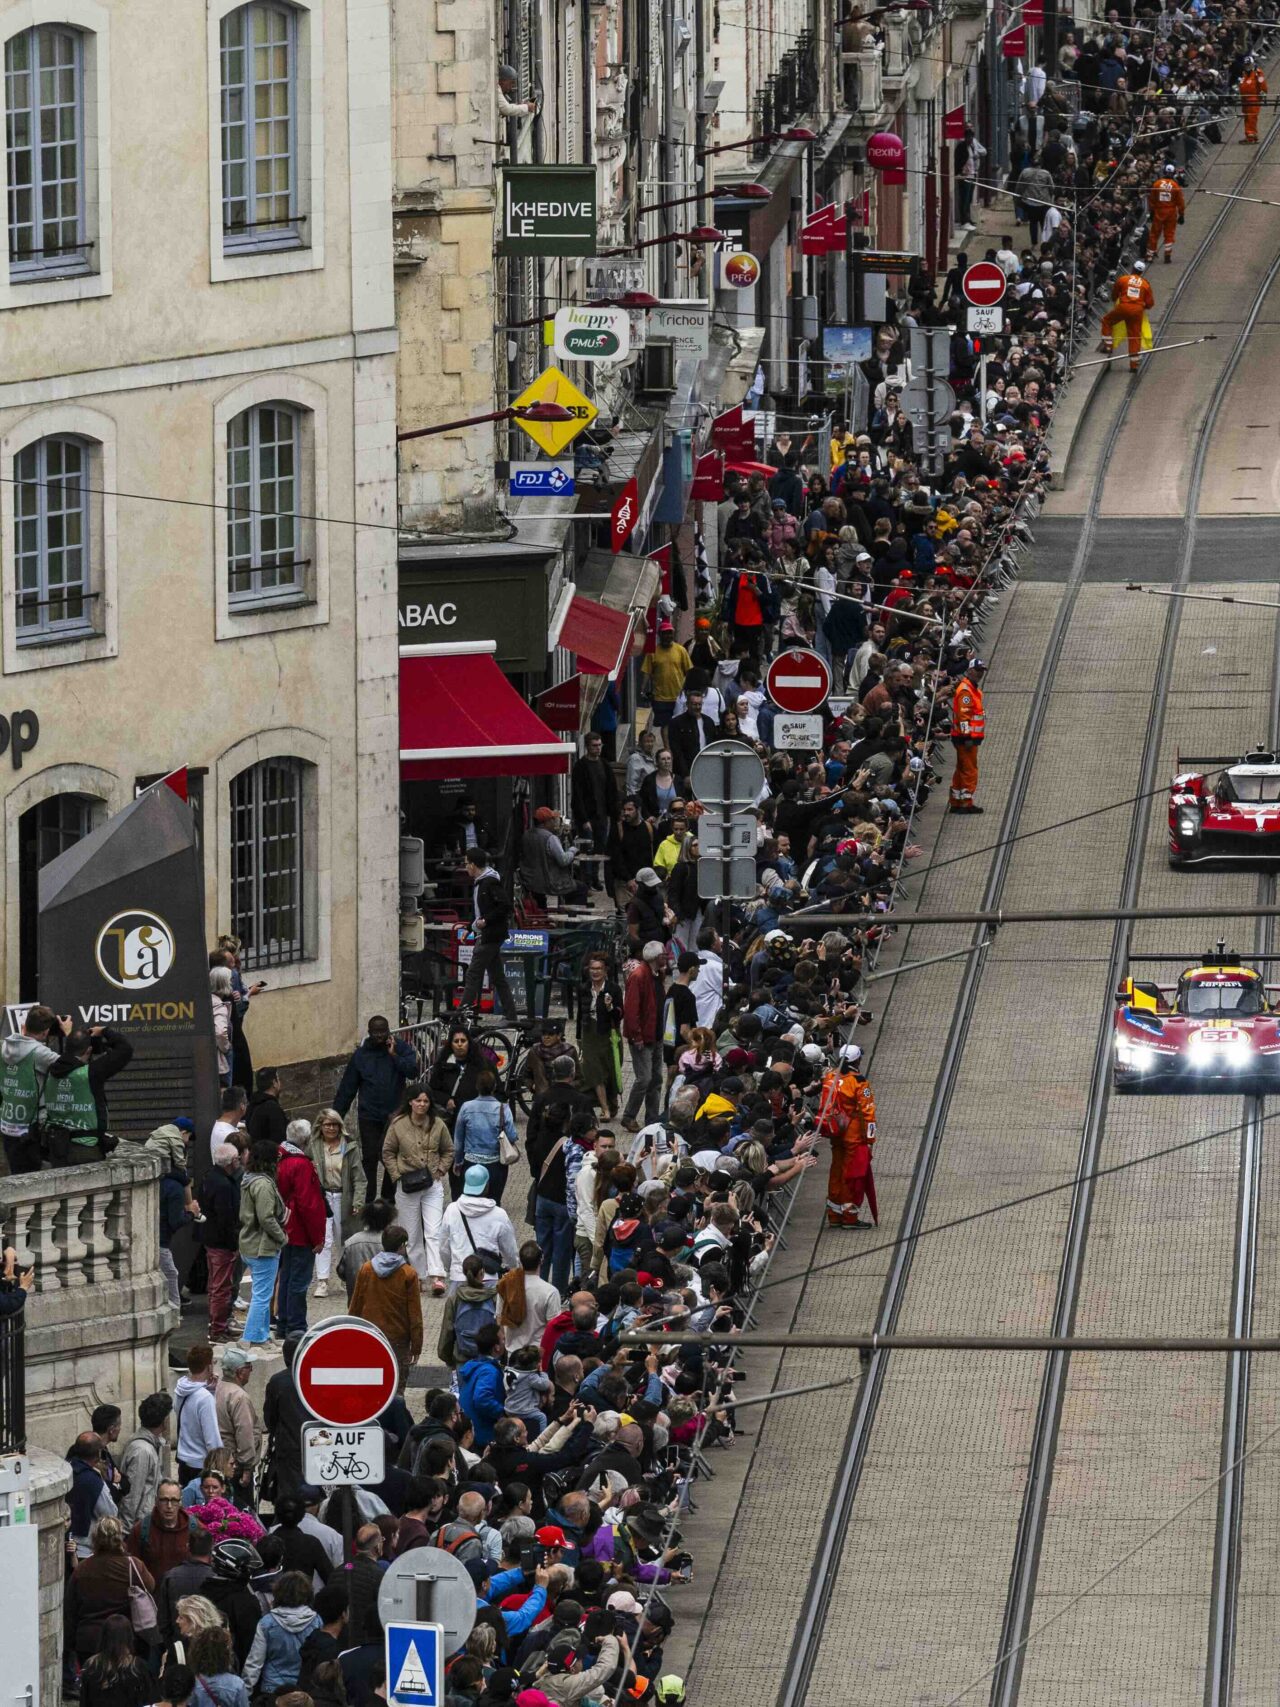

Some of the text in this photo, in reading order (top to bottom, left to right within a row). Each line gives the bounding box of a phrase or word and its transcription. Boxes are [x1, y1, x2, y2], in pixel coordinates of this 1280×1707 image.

[868, 148, 901, 159] nexity
[511, 202, 592, 217] KHEDIVE
[731, 273, 751, 283] PFG
[568, 308, 618, 328] happy
[666, 314, 704, 326] richou
[570, 337, 595, 348] PMU
[518, 473, 543, 485] FDJ
[616, 497, 633, 534] TABAC
[1199, 980, 1241, 988] Ferrari
[78, 1002, 194, 1022] VISITATION
[142, 1024, 152, 1032] du
[178, 1022, 195, 1031] ville
[1202, 1031, 1238, 1041] 51
[14, 1089, 34, 1098] TRACK
[57, 1094, 74, 1102] MEDIA
[72, 1103, 93, 1112] TRACK
[334, 1432, 366, 1446] AUF
